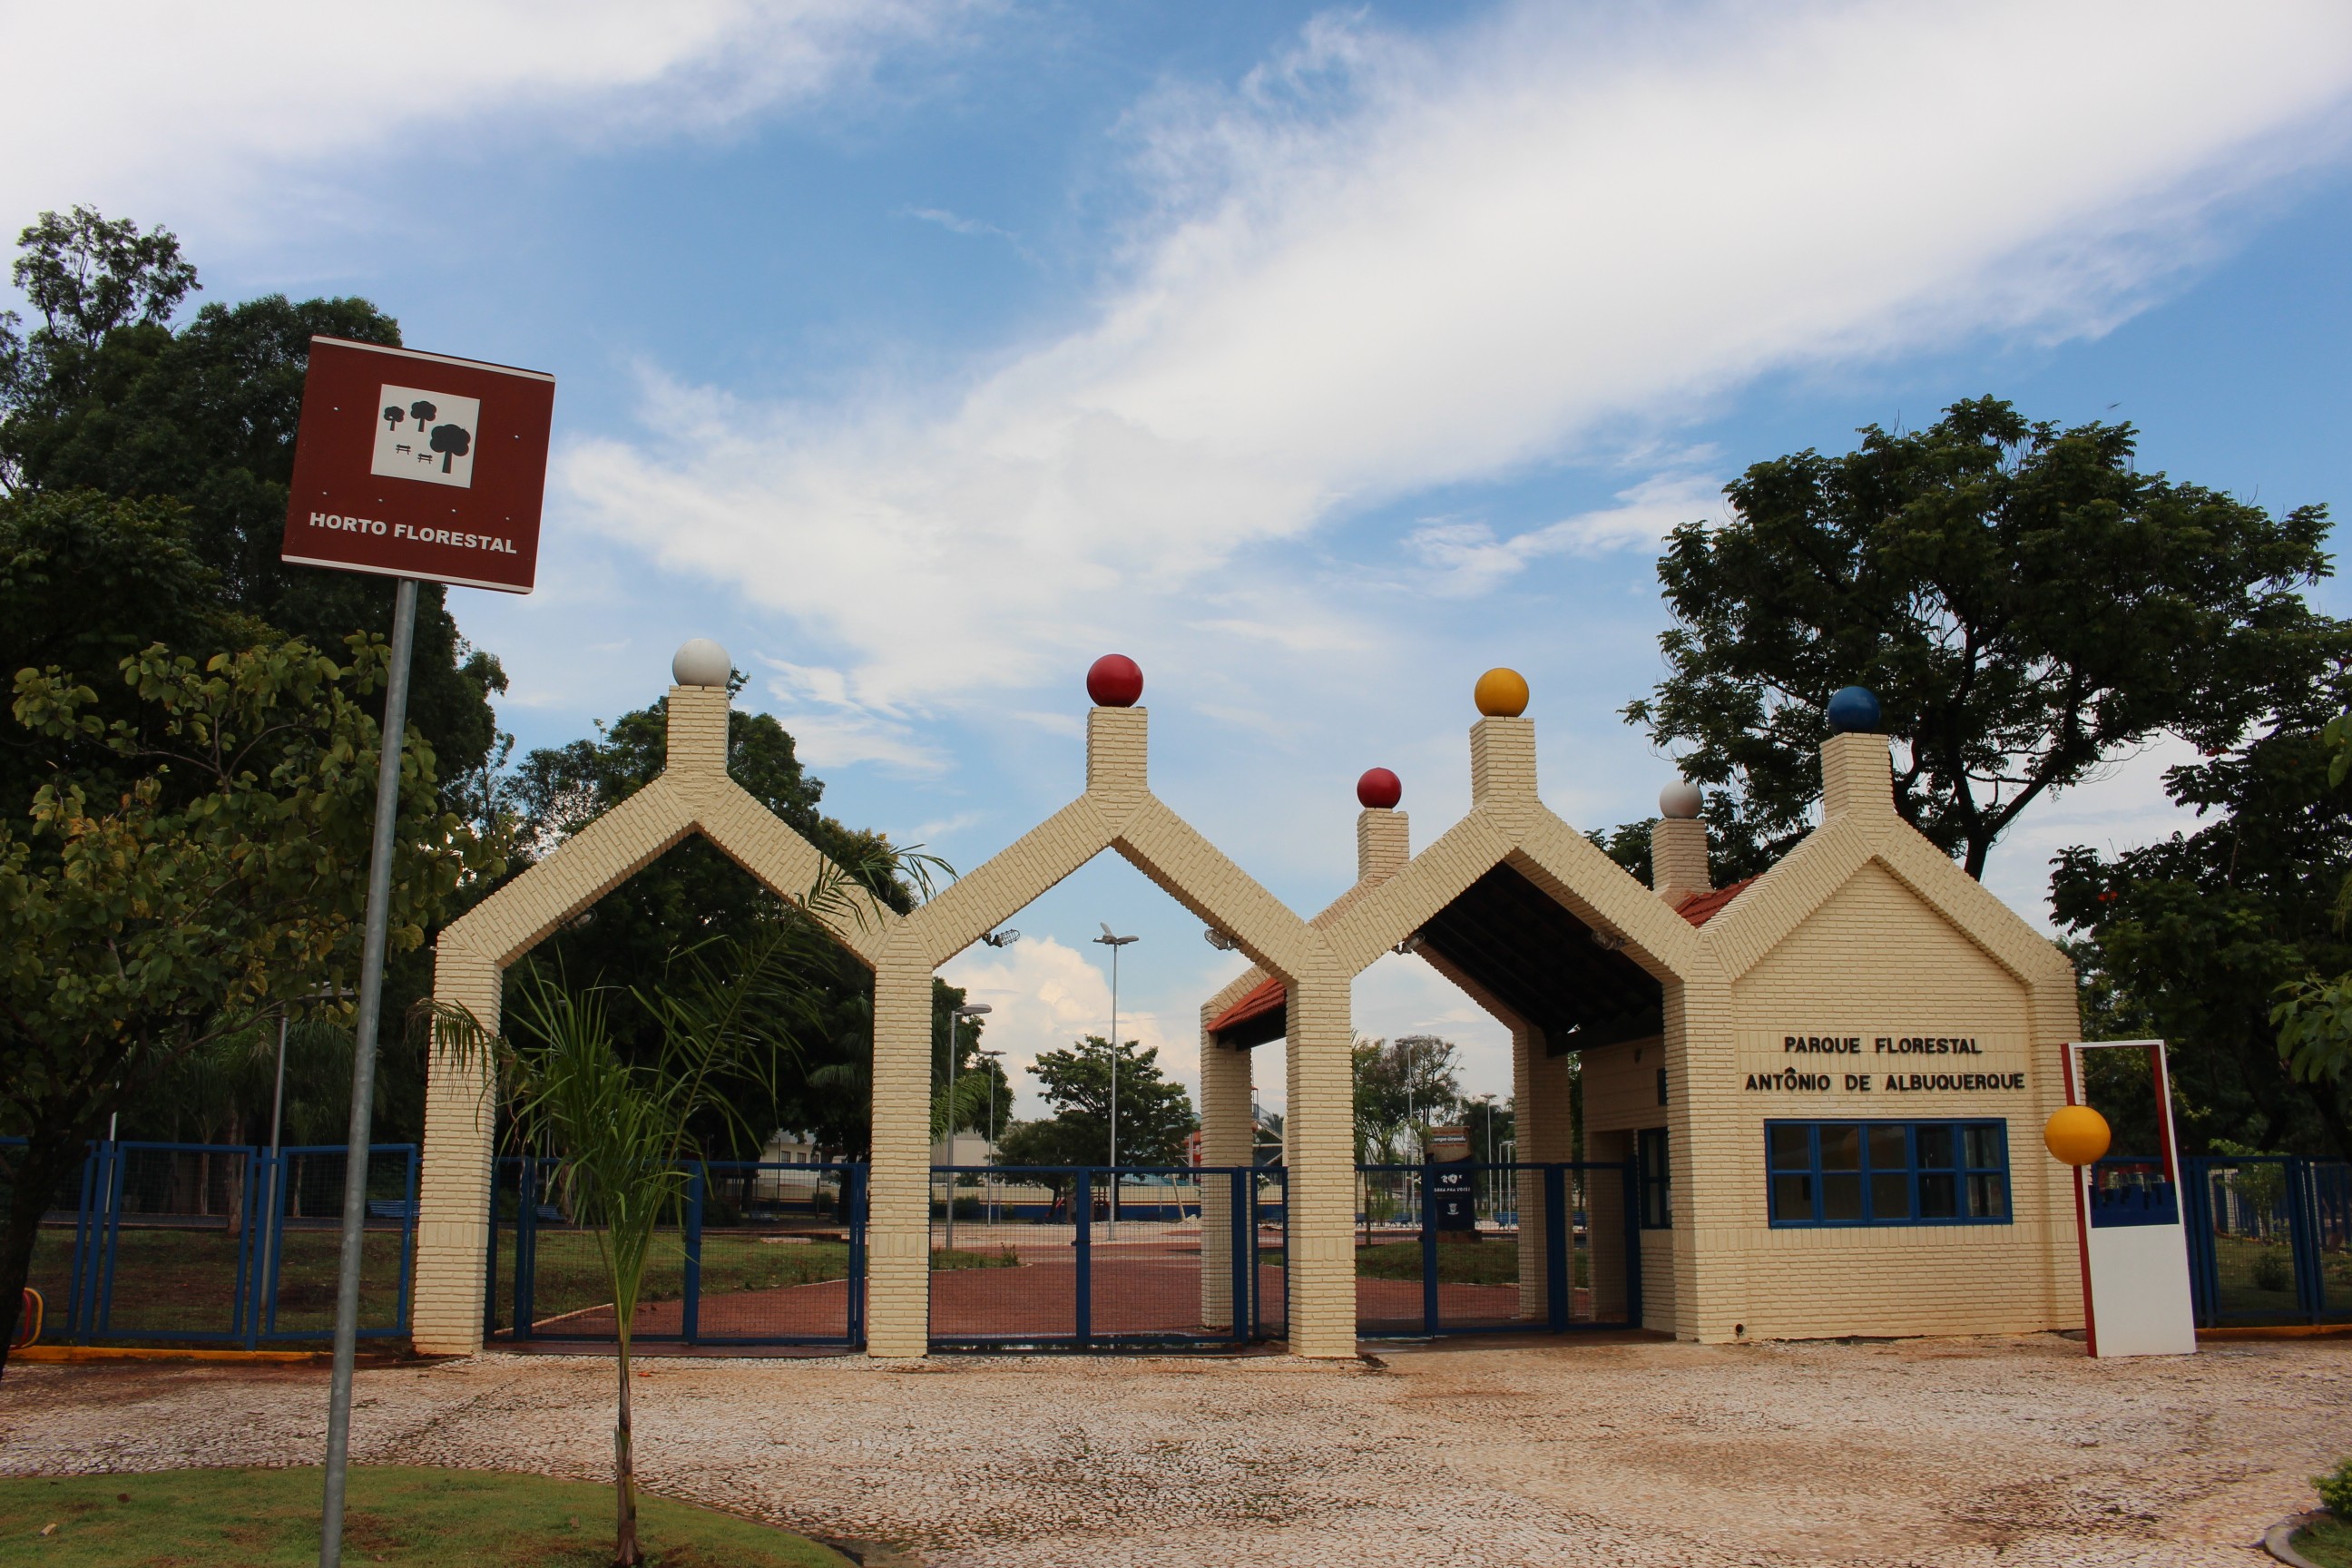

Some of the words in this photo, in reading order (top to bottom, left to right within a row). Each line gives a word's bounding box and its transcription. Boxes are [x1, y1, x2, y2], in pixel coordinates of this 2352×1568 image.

[309, 513, 387, 535] HORTO
[394, 524, 517, 554] FLORESTAL
[1784, 1036, 1861, 1054] PARQUE
[1875, 1037, 1983, 1054] FLORESTAL
[1745, 1066, 1831, 1091] ANTÔNIO
[1845, 1074, 1871, 1092] DE
[1885, 1073, 2025, 1092] ALBUQUERQUE
